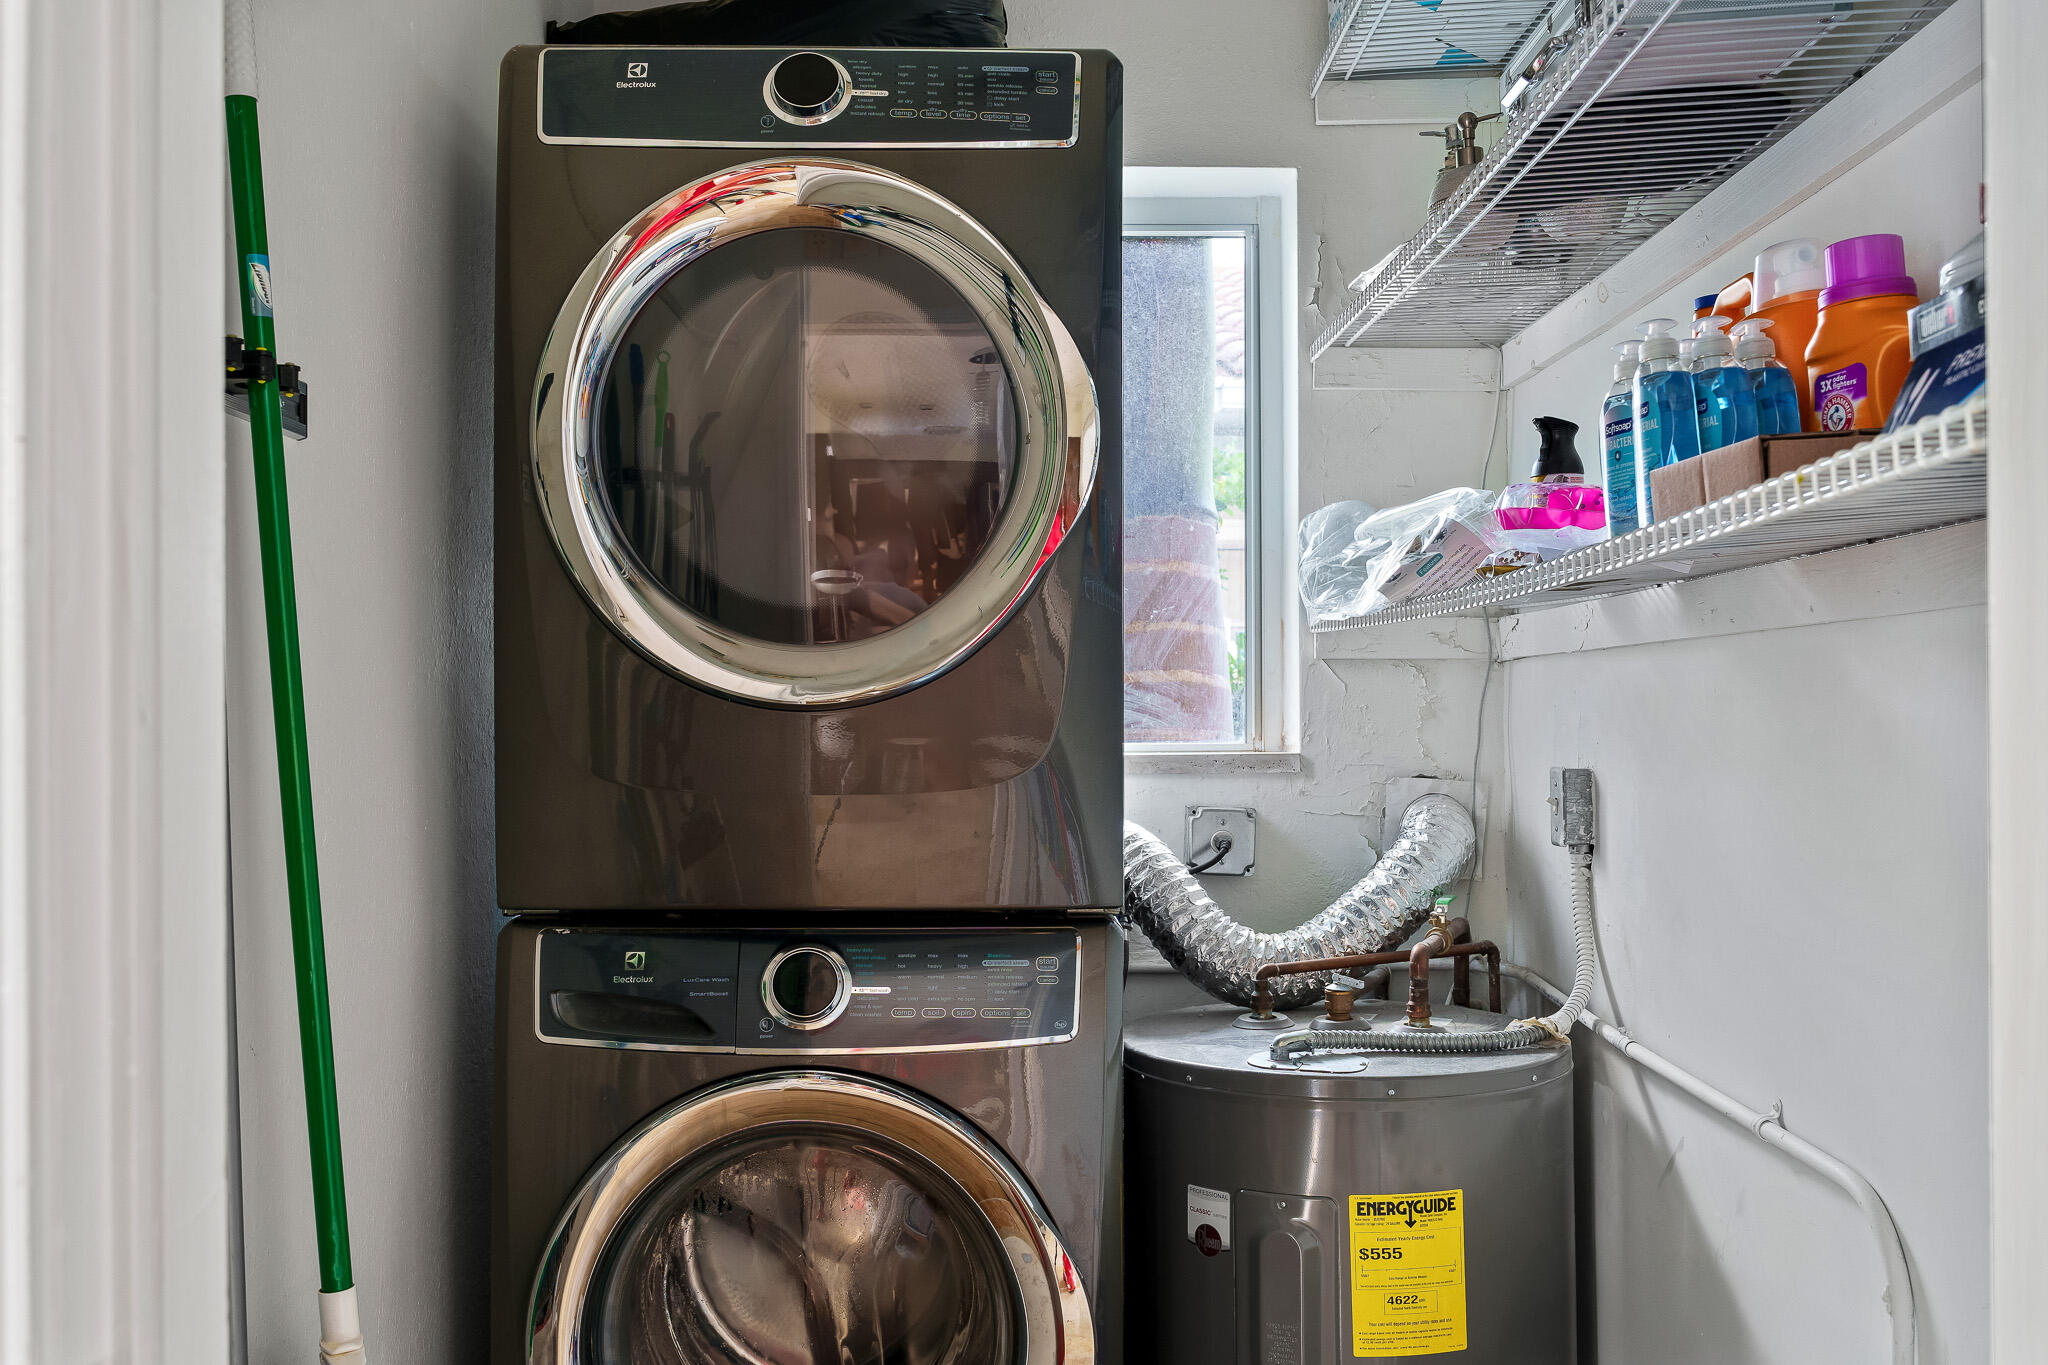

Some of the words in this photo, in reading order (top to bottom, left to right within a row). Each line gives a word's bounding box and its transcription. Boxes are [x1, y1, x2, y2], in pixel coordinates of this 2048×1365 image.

[616, 81, 657, 89] Electrolux
[983, 113, 1010, 121] options
[1833, 374, 1847, 383] odor
[1820, 379, 1832, 393] 3X
[1605, 422, 1632, 435] Softsoap
[613, 975, 654, 984] Electrolux
[984, 1009, 1010, 1017] options
[1189, 1187, 1229, 1200] PROFESSIONAL
[1189, 1206, 1212, 1216] CLASSIC
[1359, 1247, 1403, 1262] $555
[1387, 1294, 1418, 1305] 4622
